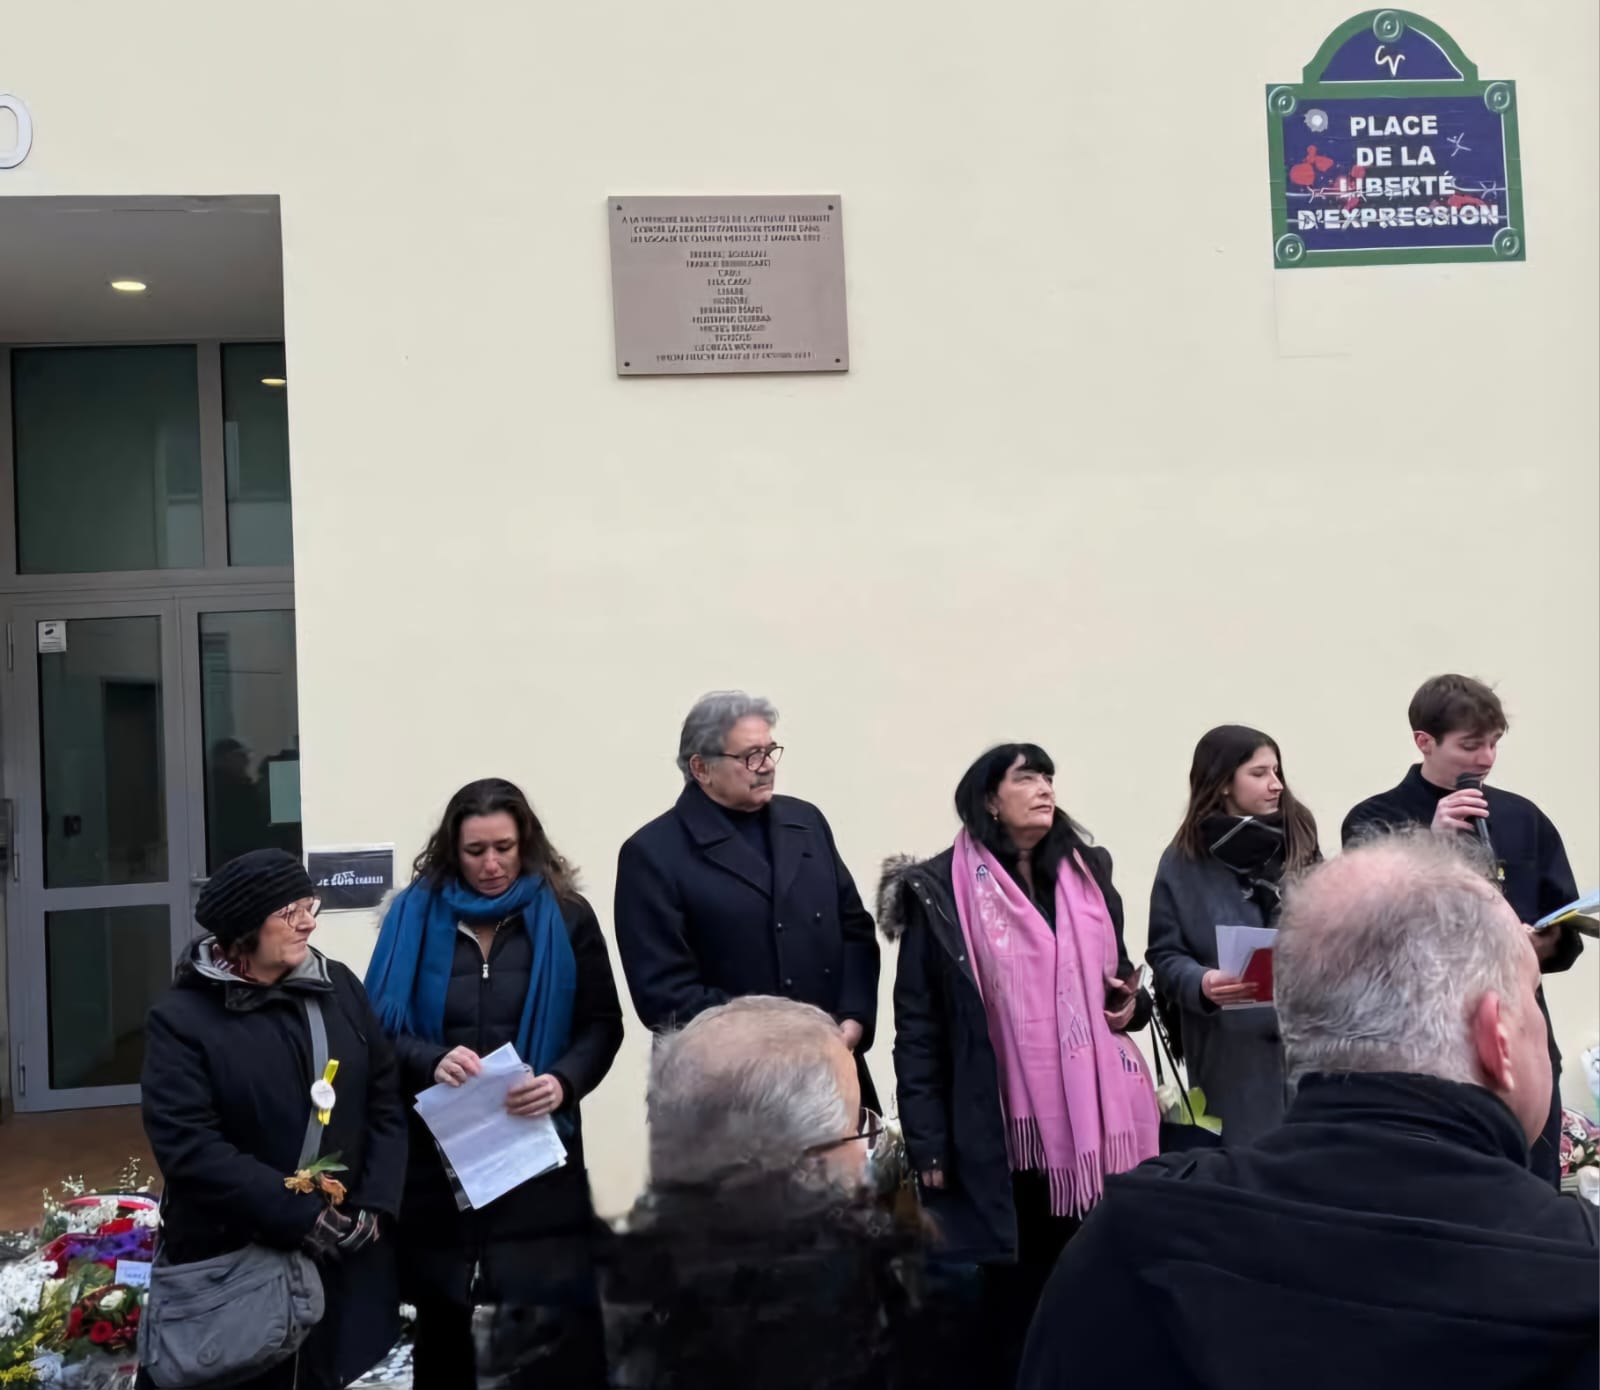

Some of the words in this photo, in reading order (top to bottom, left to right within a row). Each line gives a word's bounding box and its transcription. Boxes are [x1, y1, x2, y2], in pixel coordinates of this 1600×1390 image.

[1350, 115, 1438, 137] PLACE
[1356, 146, 1392, 167] DE
[1401, 145, 1436, 166] LA
[1339, 170, 1456, 198] LIBERTÉ
[1297, 204, 1499, 230] D'EXPRESSION
